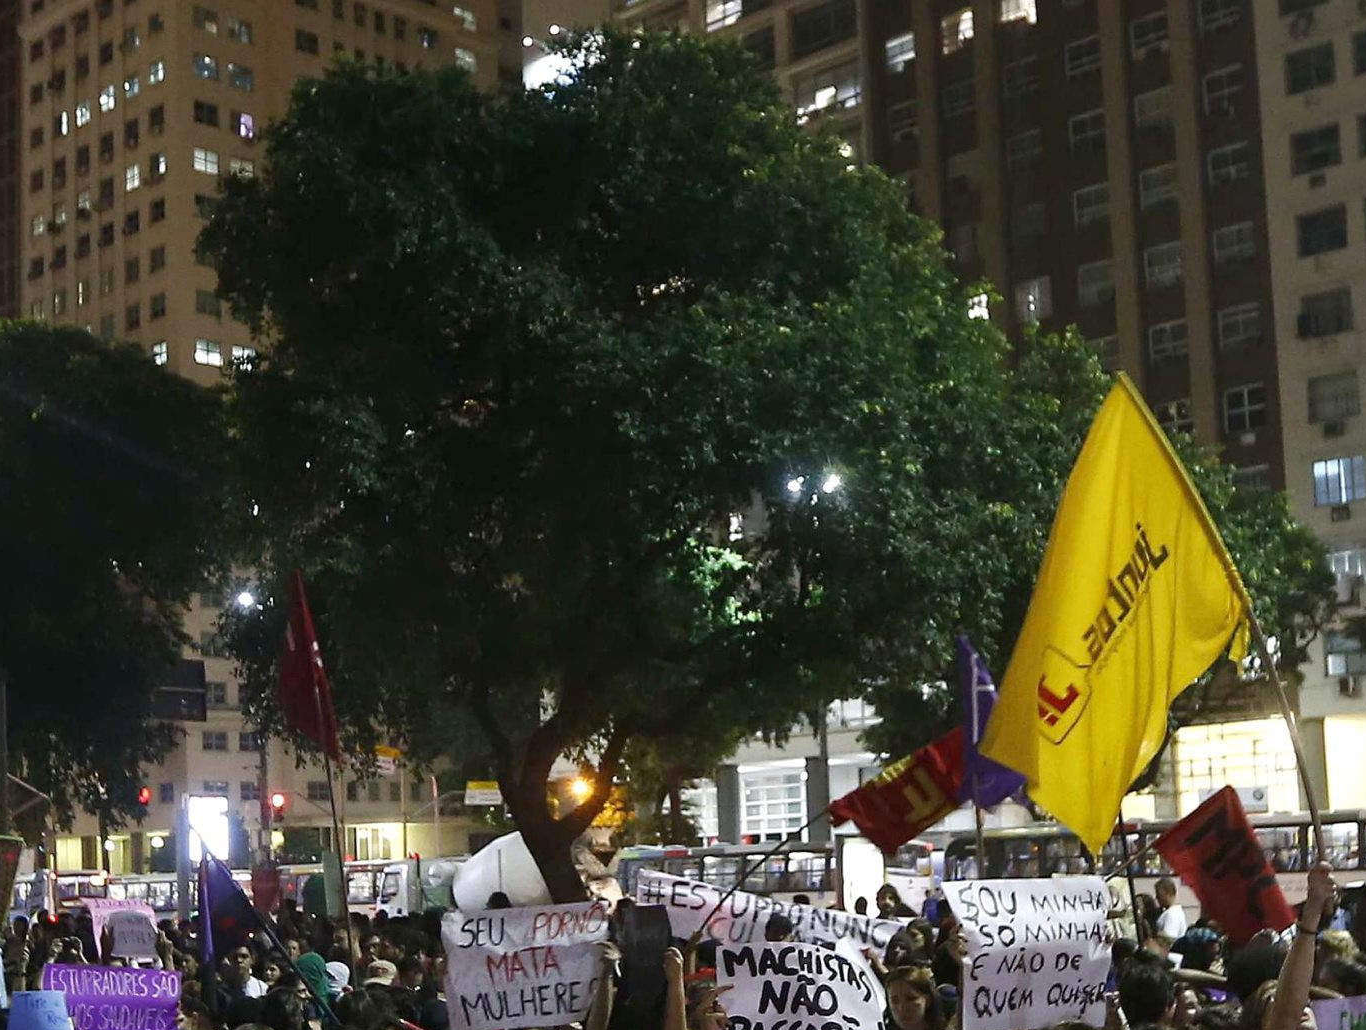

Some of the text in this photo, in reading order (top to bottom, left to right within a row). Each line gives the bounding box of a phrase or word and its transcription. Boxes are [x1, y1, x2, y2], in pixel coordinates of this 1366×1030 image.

[458, 917, 504, 948] SEU
[810, 910, 894, 948] NUNC
[979, 918, 1016, 948] SÓ
[487, 946, 562, 986] MATA
[996, 947, 1045, 975] NÃO
[50, 967, 179, 998] ESTUPRADORES SÃO
[758, 974, 838, 1016] NÃO
[973, 986, 1033, 1018] QUEM
